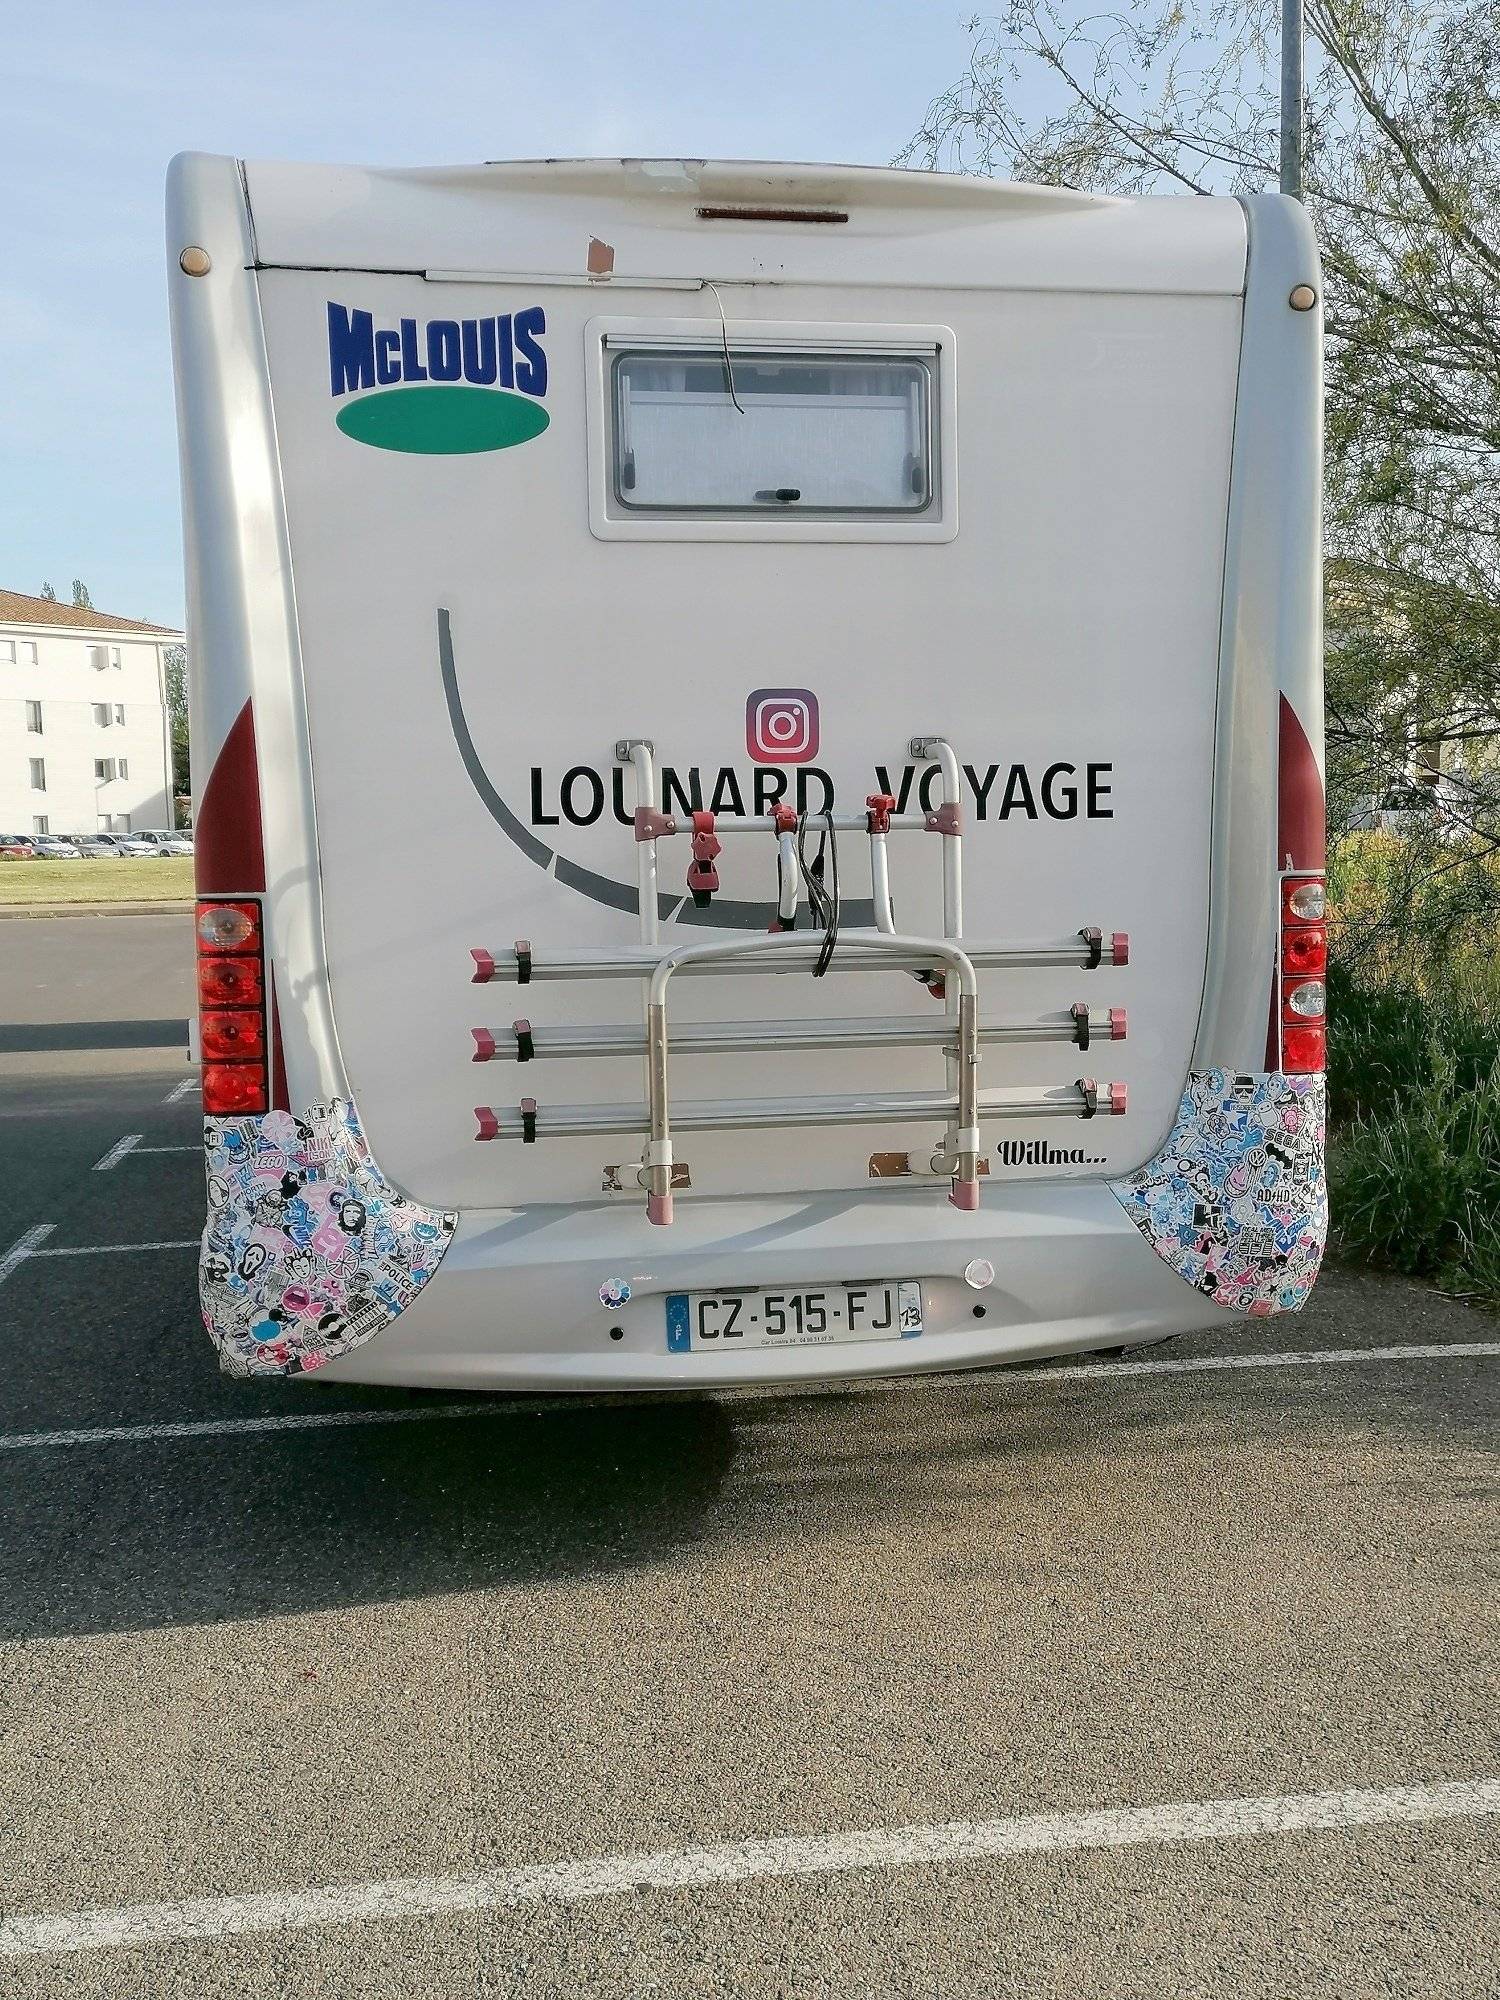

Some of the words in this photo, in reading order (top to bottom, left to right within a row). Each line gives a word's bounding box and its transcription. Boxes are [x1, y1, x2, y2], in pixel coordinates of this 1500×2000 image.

[875, 762, 1114, 821] VOYAGE
[997, 1140, 1107, 1166] Willma...
[1264, 1129, 1301, 1151] SEGA
[253, 1155, 285, 1170] LEGO
[383, 1263, 415, 1291] POLICE
[698, 1290, 892, 1339] CZ-515-FJ
